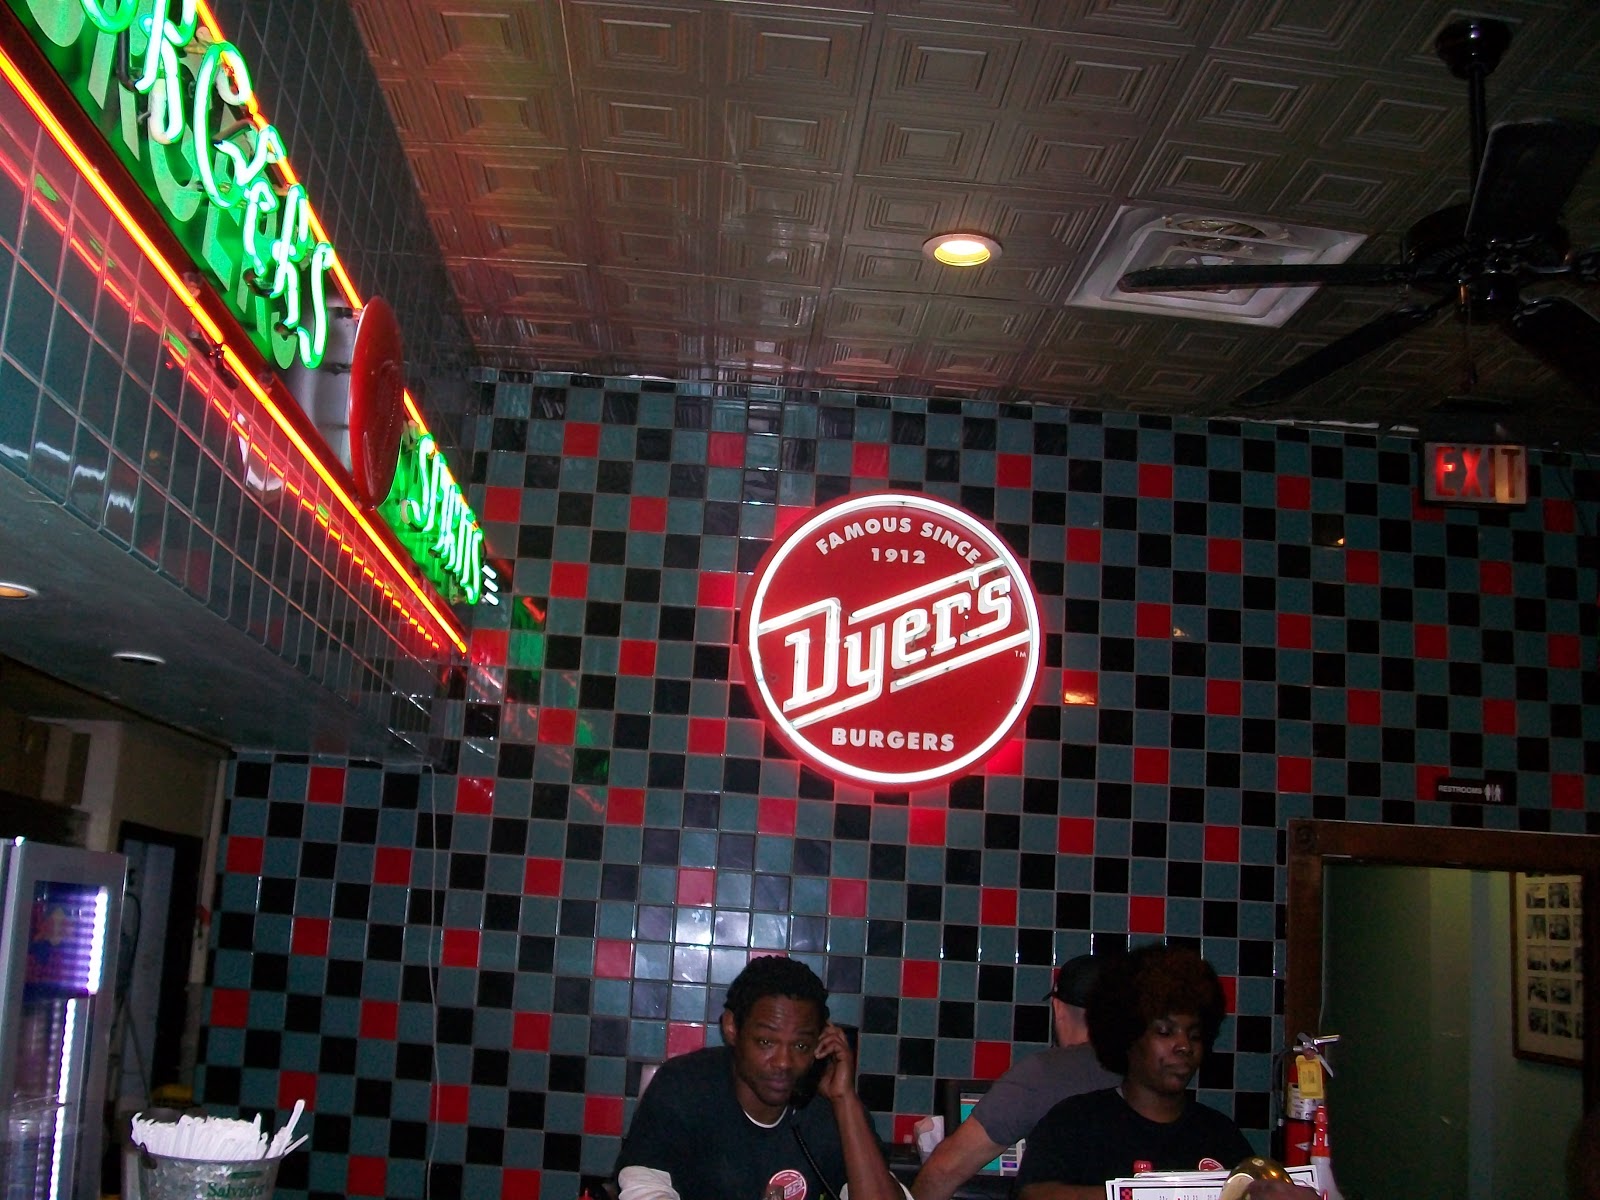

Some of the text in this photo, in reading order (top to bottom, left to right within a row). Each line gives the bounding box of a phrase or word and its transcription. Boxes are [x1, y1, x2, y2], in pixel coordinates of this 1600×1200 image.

[1435, 446, 1520, 498] EXIT
[815, 517, 982, 565] FAMOUS SINCE
[871, 547, 926, 564] 1912
[831, 727, 955, 752] BURGERS
[1438, 784, 1483, 795] RESTROOMS
